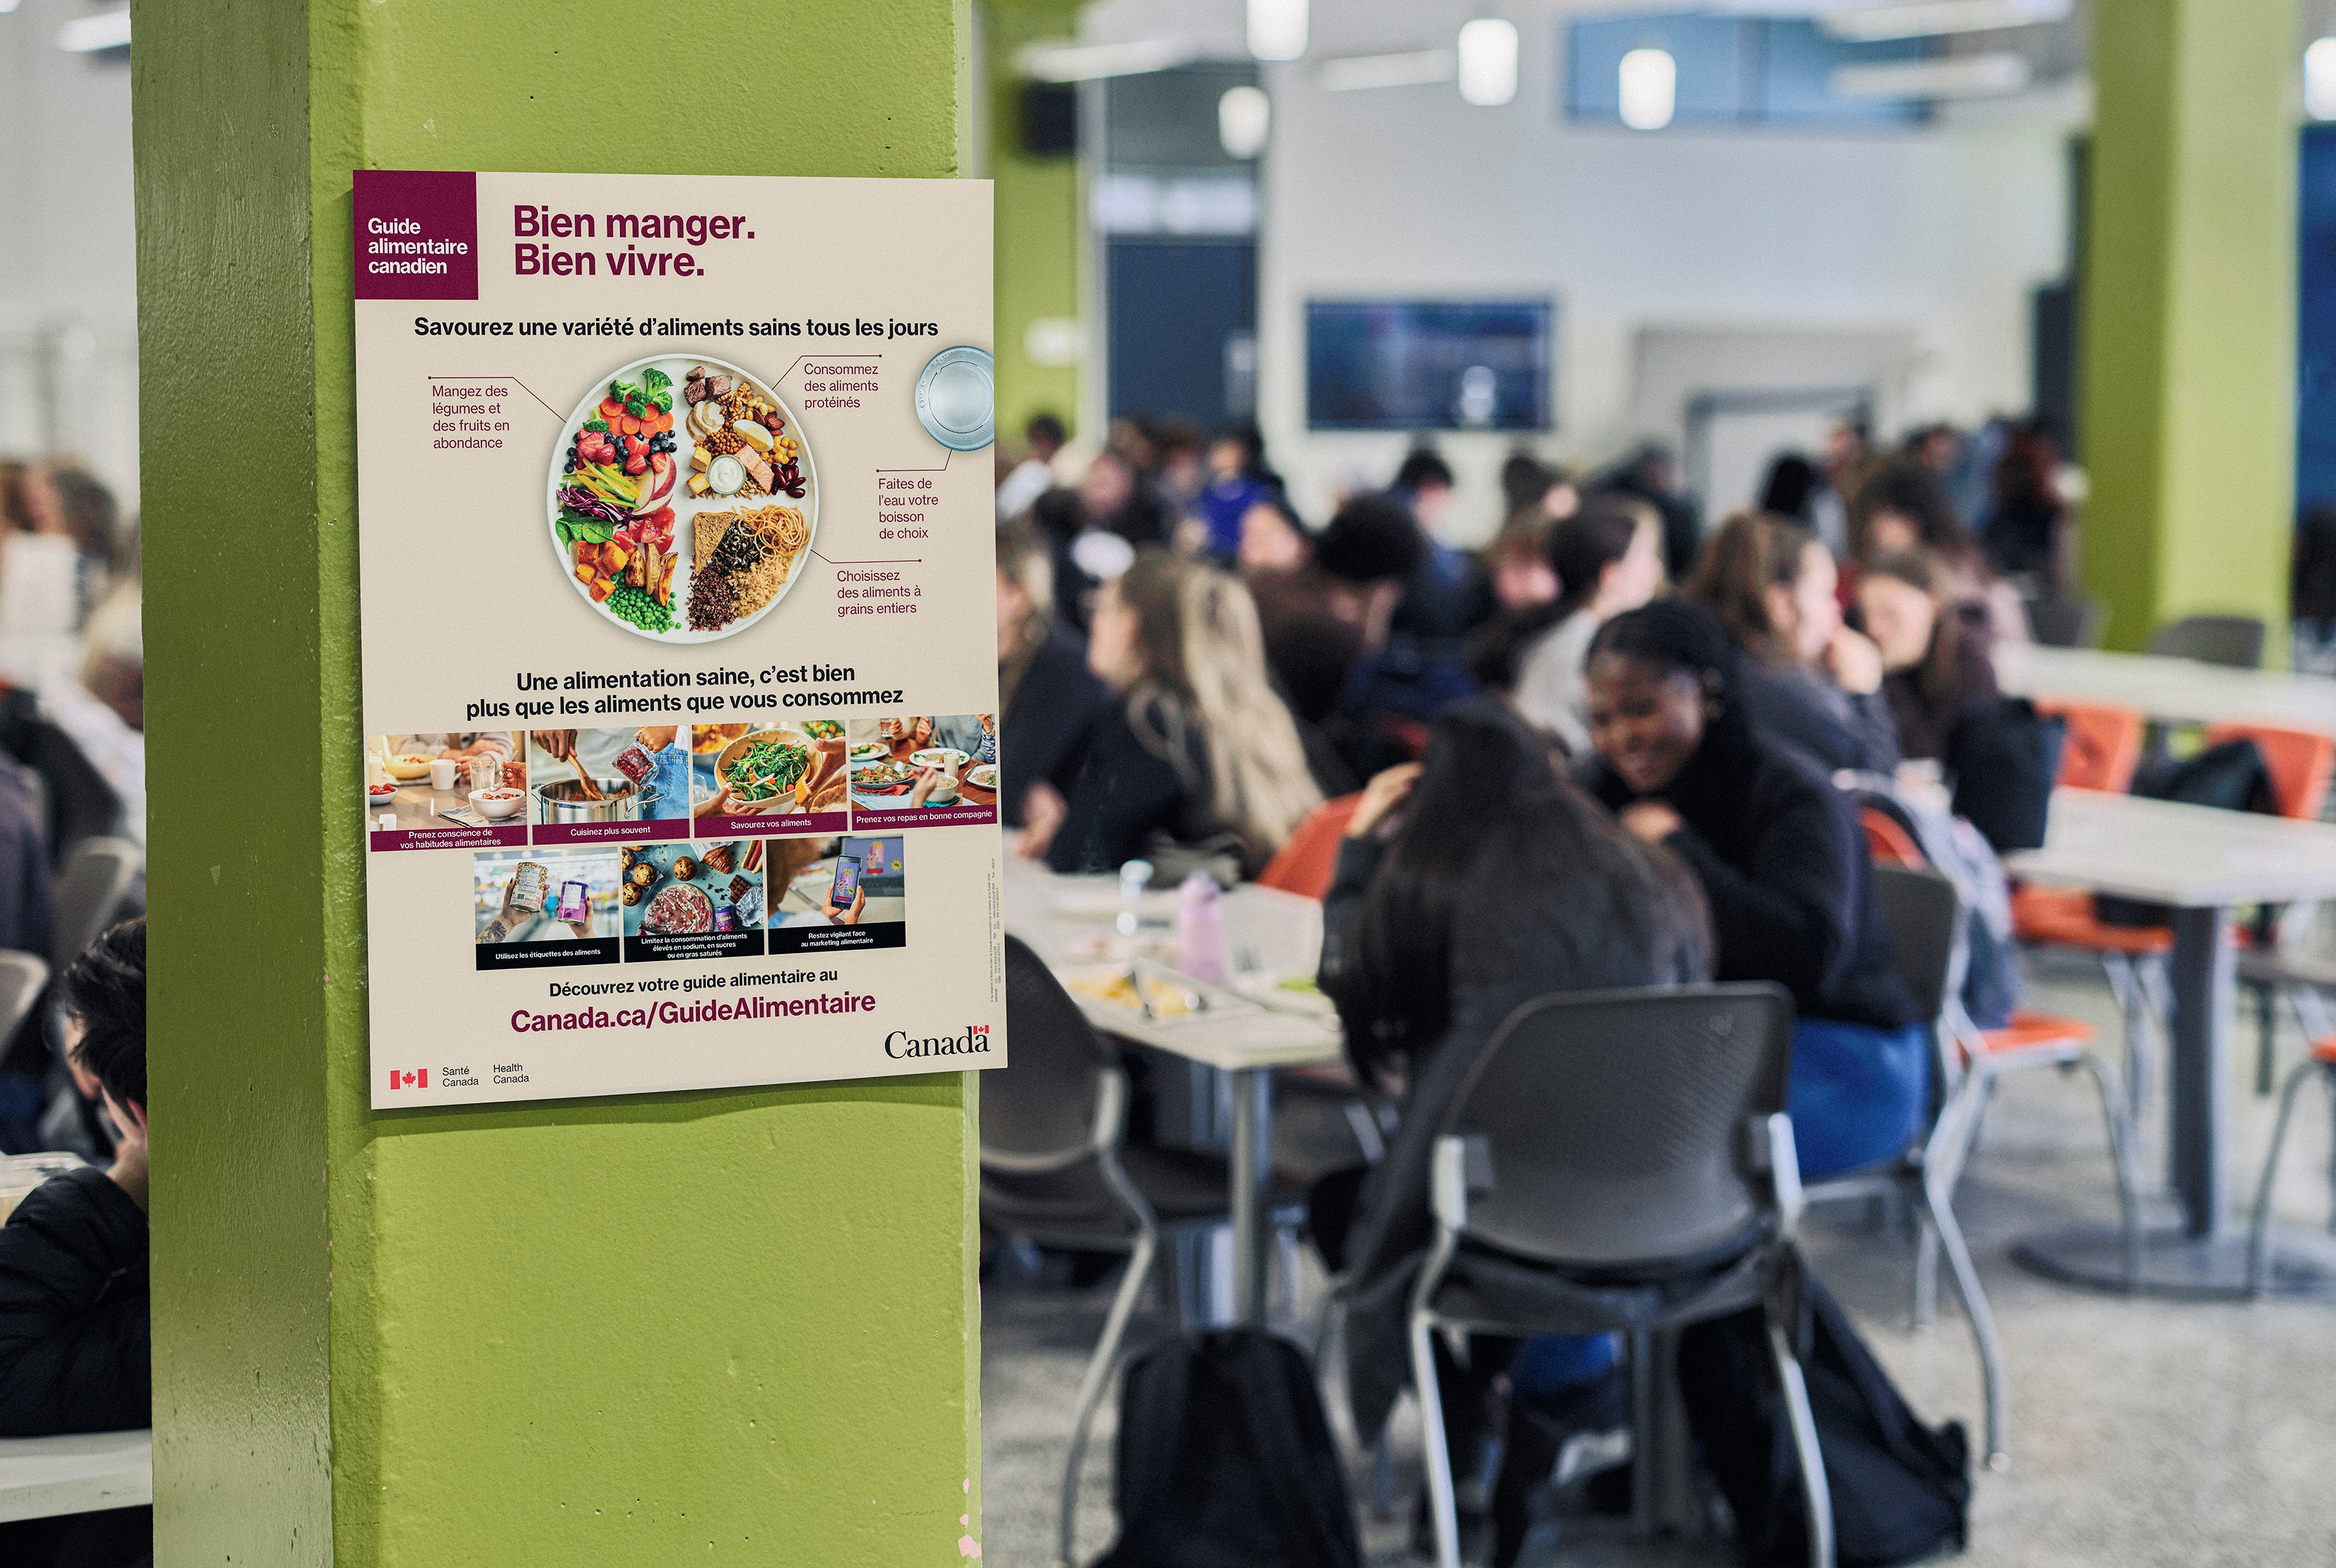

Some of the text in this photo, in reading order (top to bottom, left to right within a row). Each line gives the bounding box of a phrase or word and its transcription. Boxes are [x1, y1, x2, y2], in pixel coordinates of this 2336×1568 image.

[368, 218, 421, 234] Guide
[514, 205, 755, 245] Bien manger.
[368, 238, 467, 254] alimentaire
[515, 243, 703, 276] Bien vivre.
[369, 258, 447, 274] canadien
[415, 317, 938, 340] Savourez une variété d’aliments sains tous les jours
[804, 364, 878, 375] Consommez
[805, 380, 878, 391] des aliments
[433, 386, 508, 399] Mangez des
[433, 402, 500, 416] légumes et
[805, 397, 860, 410] protéinés
[433, 420, 509, 431] des fruits en
[434, 437, 503, 448] abondance
[879, 478, 932, 489] Faites de
[879, 495, 938, 505] l’eau votre
[879, 511, 923, 522] boisson
[879, 527, 928, 539] de choix
[837, 570, 900, 581] Choisissez
[838, 585, 921, 598] des aliments à
[838, 603, 917, 617] grains entiers
[517, 664, 855, 691] Une alimentation saine, c’est bien
[467, 690, 903, 721] plus que les aliments que vous consommez
[897, 814, 917, 822] repas
[953, 810, 993, 819] compagnie
[730, 821, 766, 829] Savourez
[781, 819, 812, 827] aliments
[437, 830, 481, 838] conscience
[570, 826, 651, 836] Cuisinez plus souvent
[416, 840, 453, 848] habitudes
[454, 838, 501, 847] alimentaires
[809, 939, 839, 947] marketing
[840, 937, 874, 945] alimentaire
[530, 950, 561, 959] étiquettes
[574, 948, 600, 956] aliments
[550, 969, 837, 996] Découvrez votre guide alimentaire au
[511, 991, 876, 1033] Canada.ca/GuideAlimentaire
[885, 1025, 991, 1059] Canada
[443, 1066, 469, 1076] Santé
[494, 1063, 522, 1073] Health
[443, 1077, 478, 1087] Canada
[494, 1074, 529, 1084] Canada
